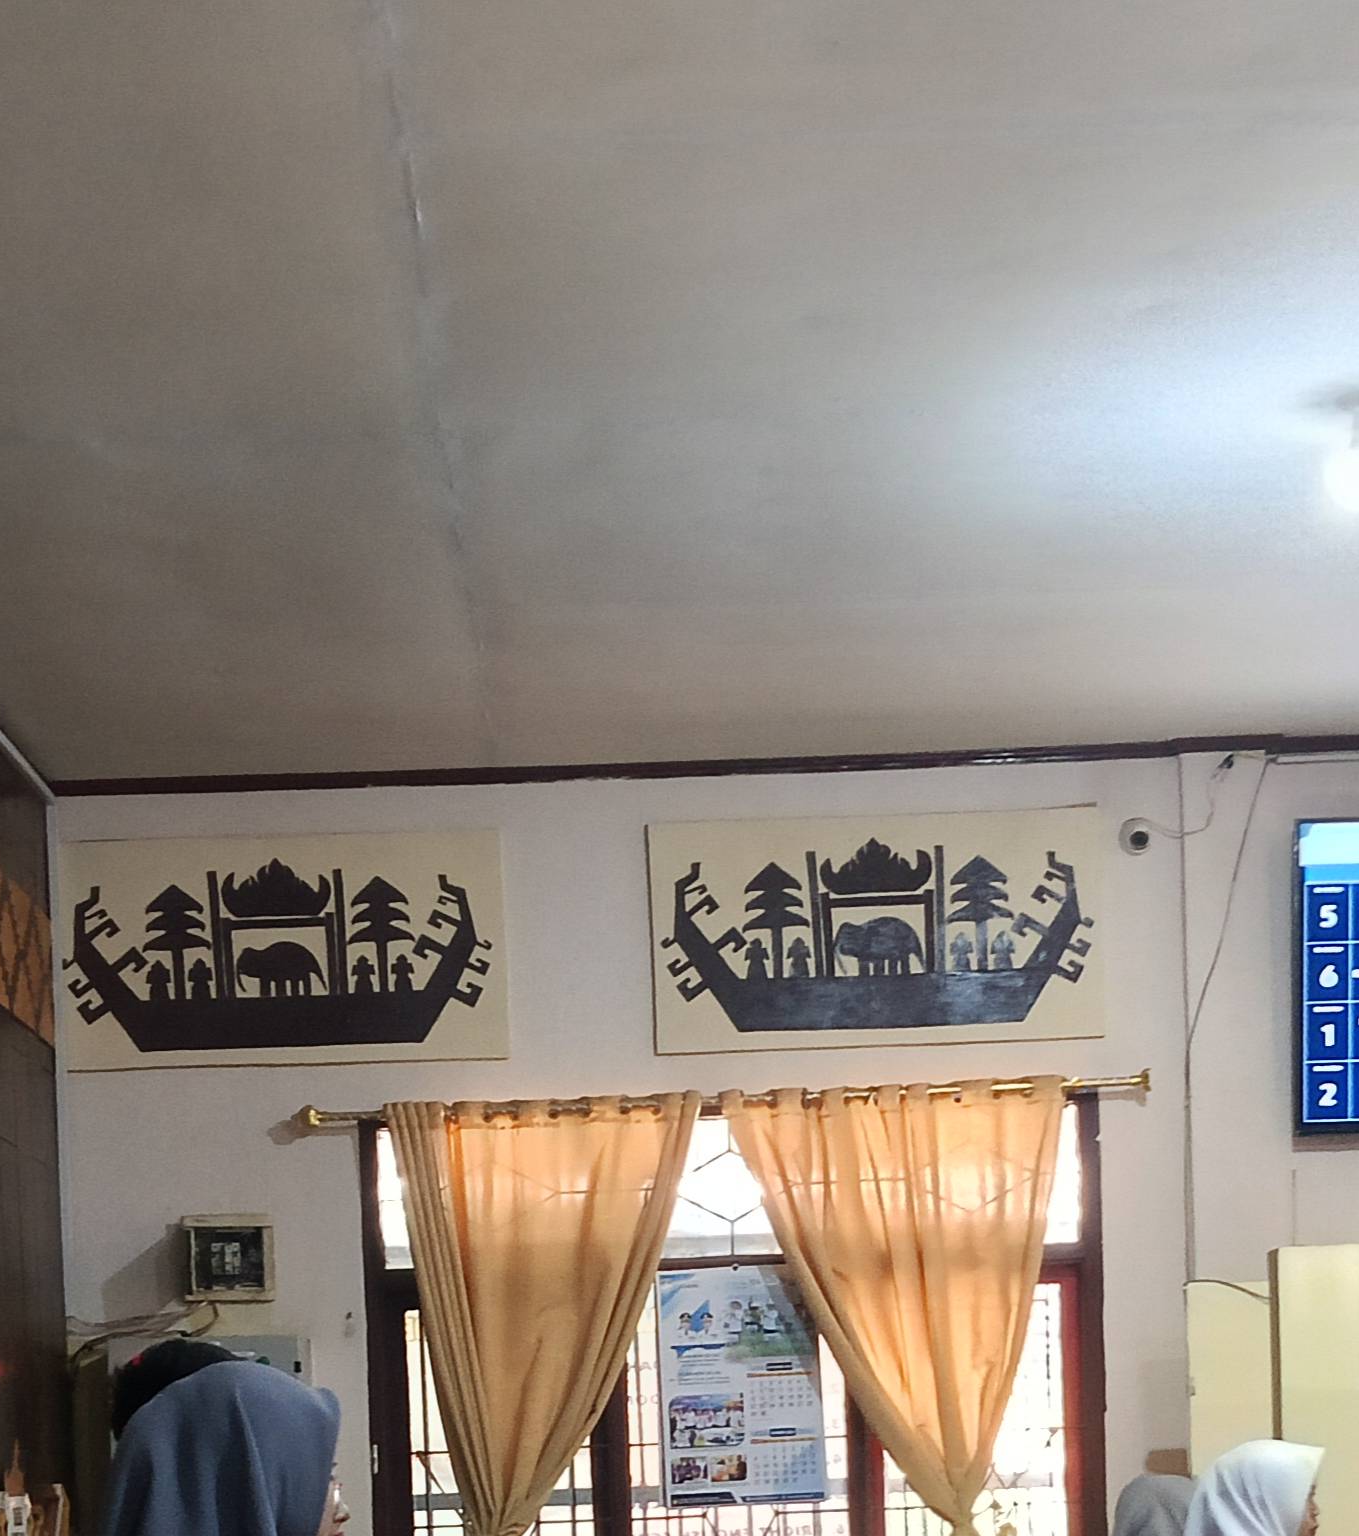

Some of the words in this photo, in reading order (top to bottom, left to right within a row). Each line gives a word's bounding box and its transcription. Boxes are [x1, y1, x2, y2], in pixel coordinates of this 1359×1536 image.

[1319, 903, 1340, 929] 5
[1319, 964, 1340, 989] 6
[1320, 1023, 1336, 1047] 1
[1319, 1083, 1339, 1107] 2
